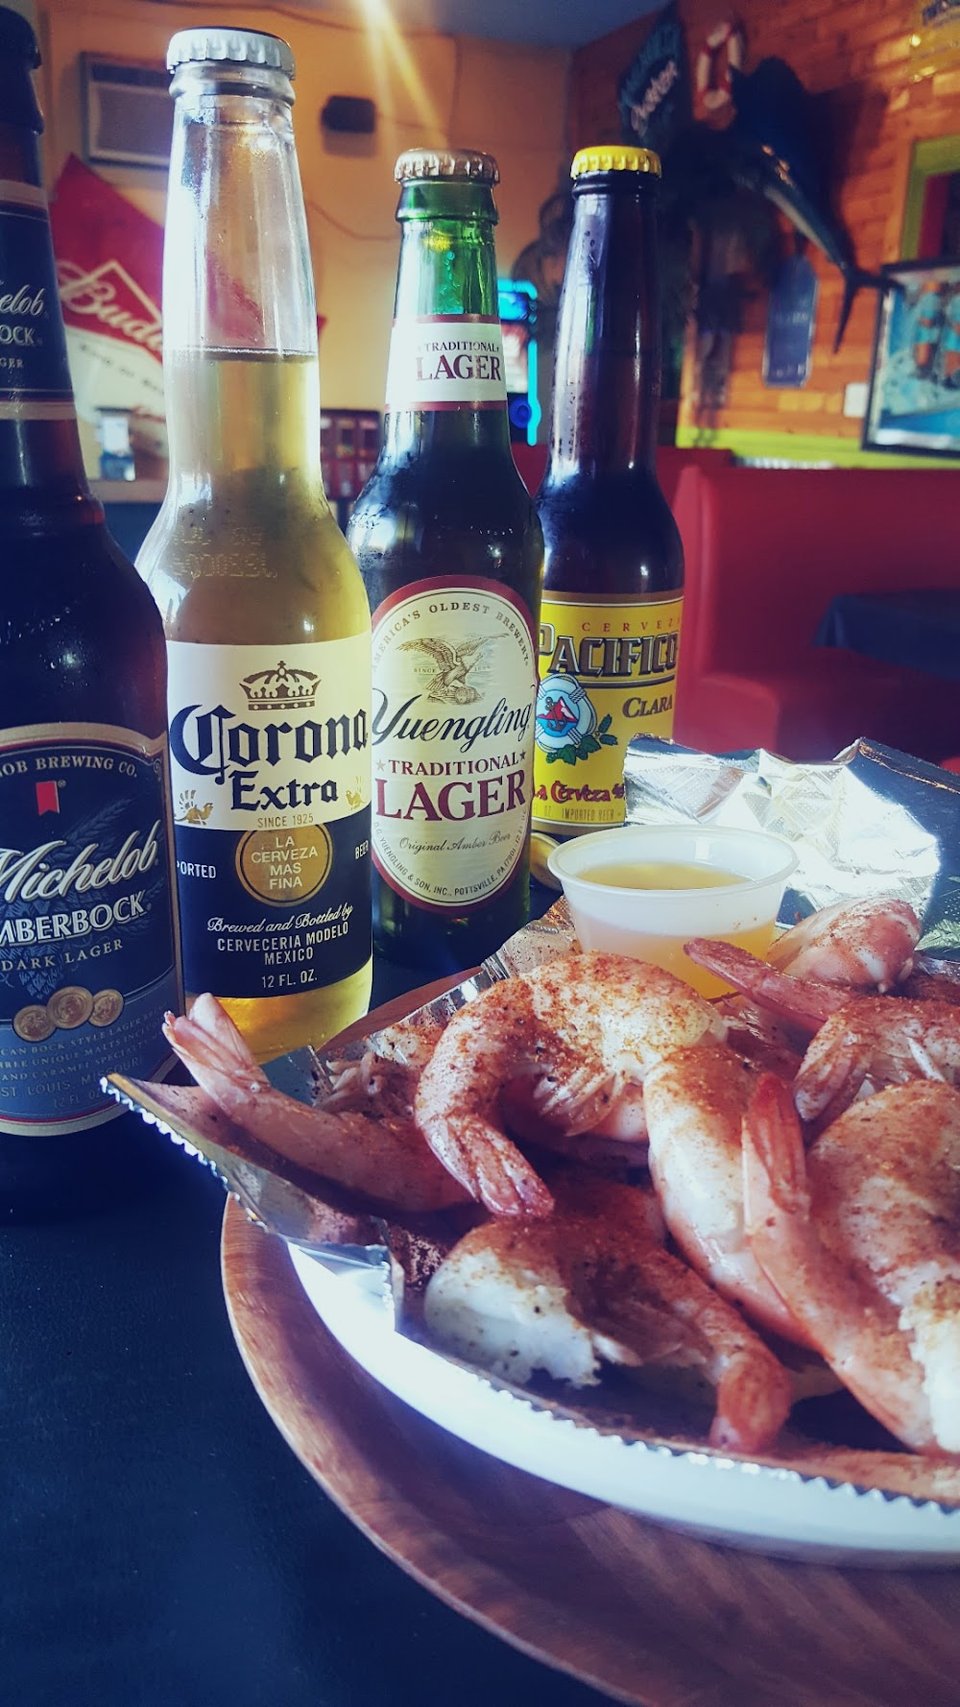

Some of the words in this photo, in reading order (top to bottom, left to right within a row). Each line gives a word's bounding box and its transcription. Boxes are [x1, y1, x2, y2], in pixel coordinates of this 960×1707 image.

[0, 281, 46, 316] elob
[425, 341, 497, 352] TRADITIONAL
[416, 355, 502, 381] LAGER
[429, 602, 490, 614] OLDEST
[495, 611, 528, 661] BREWERY
[582, 615, 680, 632] CERVEZ
[537, 622, 679, 678] PACIFICO
[622, 694, 673, 718] CLARA
[372, 688, 534, 753] Yuengling
[170, 704, 369, 786] Corona
[0, 760, 28, 778] OB
[35, 755, 114, 771] BREWING
[118, 761, 137, 778] CO.
[388, 752, 520, 776] TRADITIONAL
[228, 769, 339, 812] Extra
[375, 769, 527, 821] LAGER
[257, 818, 288, 829] SINCE
[293, 813, 314, 827] 1925
[275, 836, 295, 849] LA
[400, 837, 447, 855] Original
[447, 836, 486, 851] Amber
[0, 819, 161, 903] Michelob
[251, 846, 318, 864] CERVEZA
[270, 862, 302, 877] MAS
[269, 879, 303, 890] FINA
[207, 917, 265, 933] Brewed
[265, 916, 294, 931] and
[295, 910, 341, 930] Bottled
[340, 902, 354, 921] by
[217, 933, 302, 952] CERVECERIA
[306, 921, 349, 945] MODELO
[1, 957, 56, 973] DARK
[65, 938, 123, 963] LAGER
[264, 947, 313, 966] MEXICO
[262, 976, 274, 988] 12
[279, 974, 296, 986] FL.
[300, 968, 318, 983] OZ.
